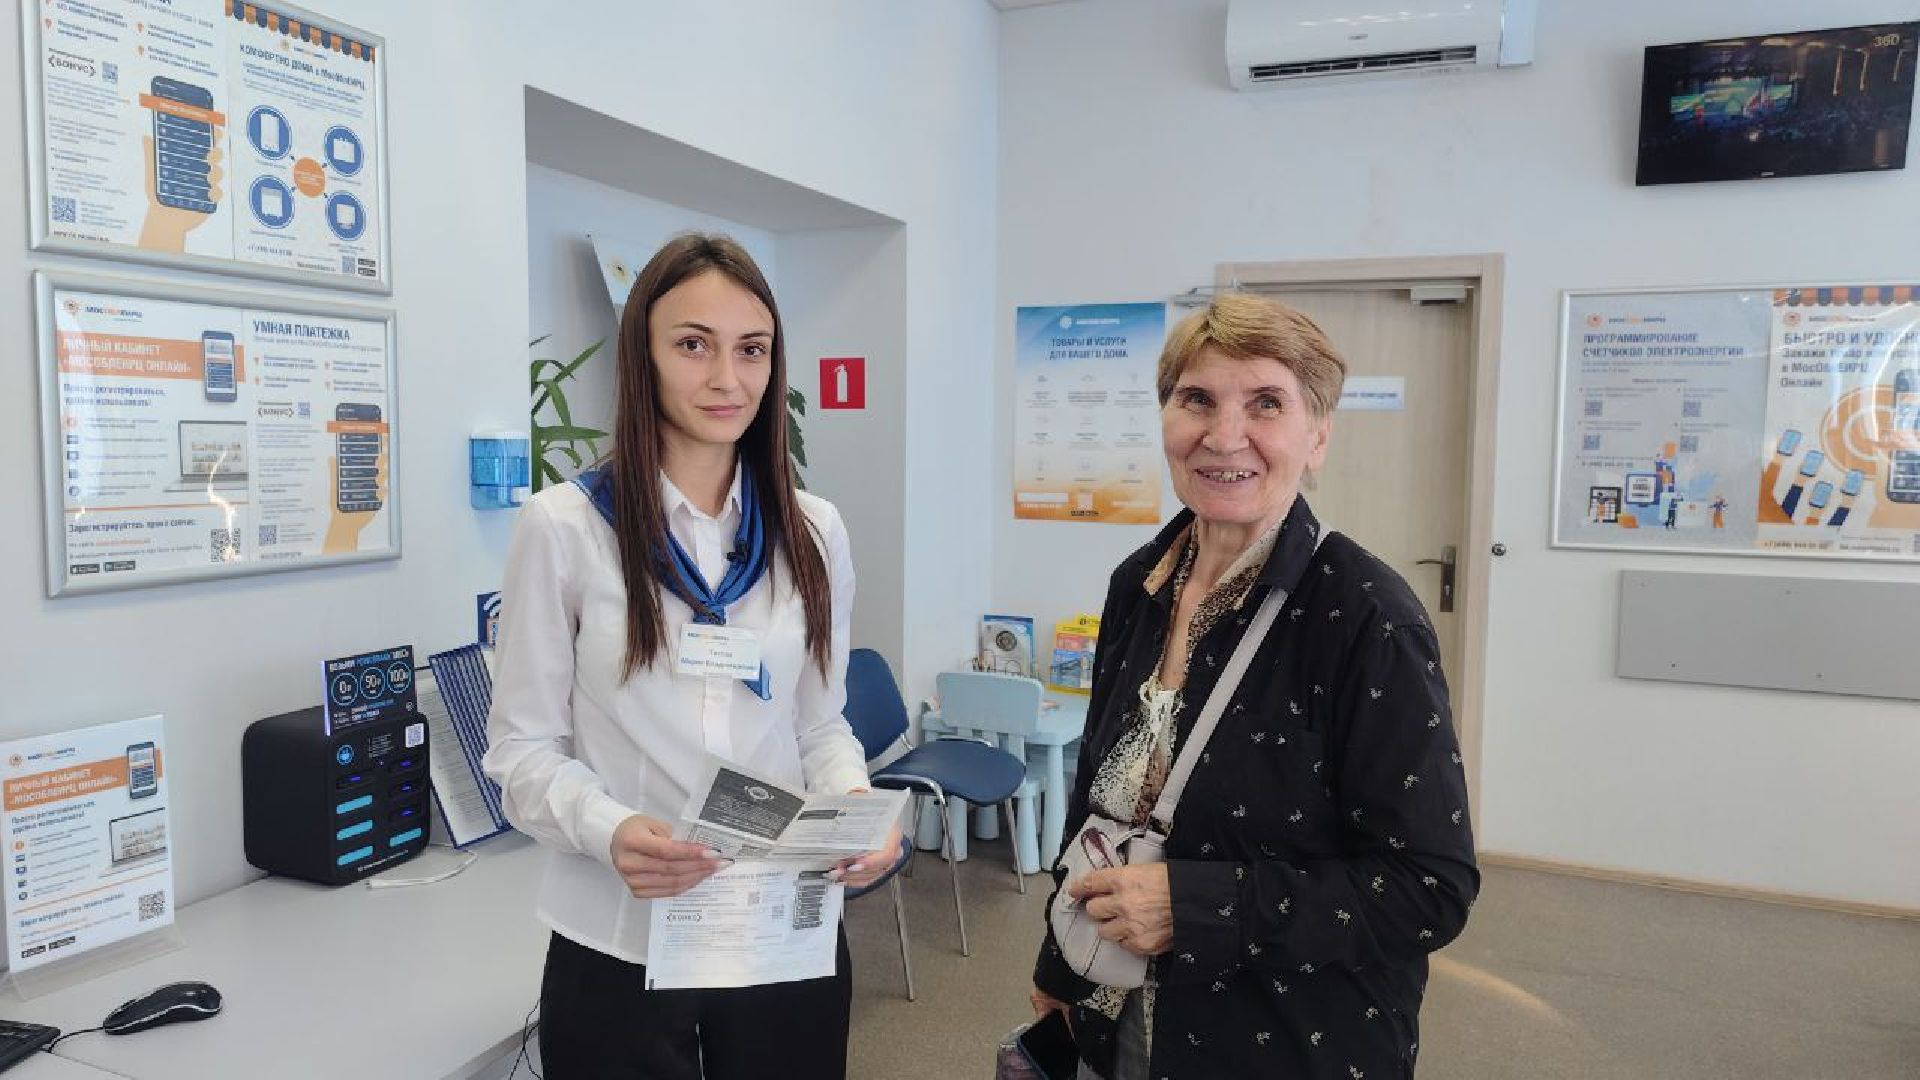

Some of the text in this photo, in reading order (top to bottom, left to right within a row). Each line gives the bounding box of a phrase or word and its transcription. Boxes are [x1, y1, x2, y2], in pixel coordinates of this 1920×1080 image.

[253, 320, 350, 341] УМНАЯ ПЛАТЕЖКА
[1052, 335, 1127, 347] ТОВАРЫ И УСЛУГИ
[1584, 332, 1699, 344] ПРОГРАММИРОВАНИЕ
[1850, 332, 1860, 344] И
[1049, 349, 1129, 361] ДЛЯ ВАШЕГО ДОМА
[1646, 346, 1744, 358] ЭЛЕКТРОЭНЕРГИИ
